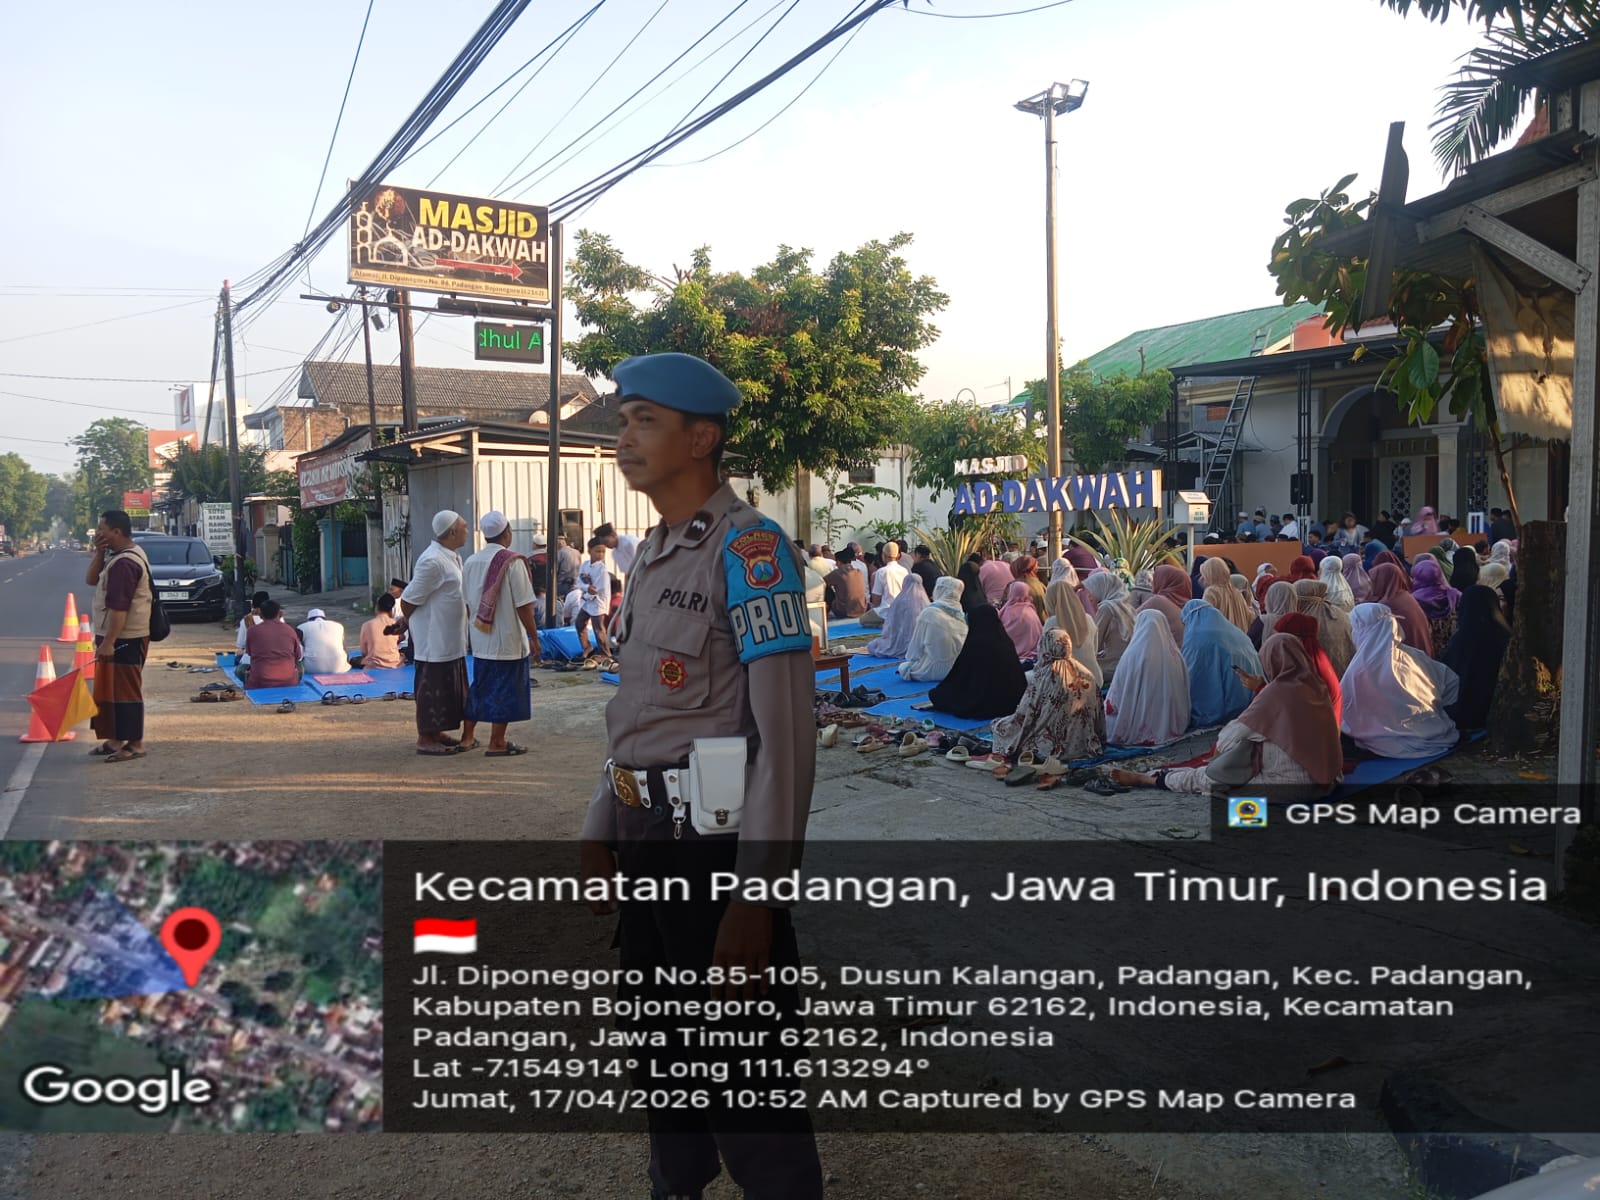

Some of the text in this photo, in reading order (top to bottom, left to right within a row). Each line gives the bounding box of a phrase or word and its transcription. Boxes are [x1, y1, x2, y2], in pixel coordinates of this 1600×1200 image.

[419, 197, 538, 238] MASJID
[411, 226, 546, 263] AD-DAKWAH
[953, 454, 1028, 476] MASJID
[953, 467, 1162, 514] AD-DAKWAH
[657, 588, 708, 613] POLRI
